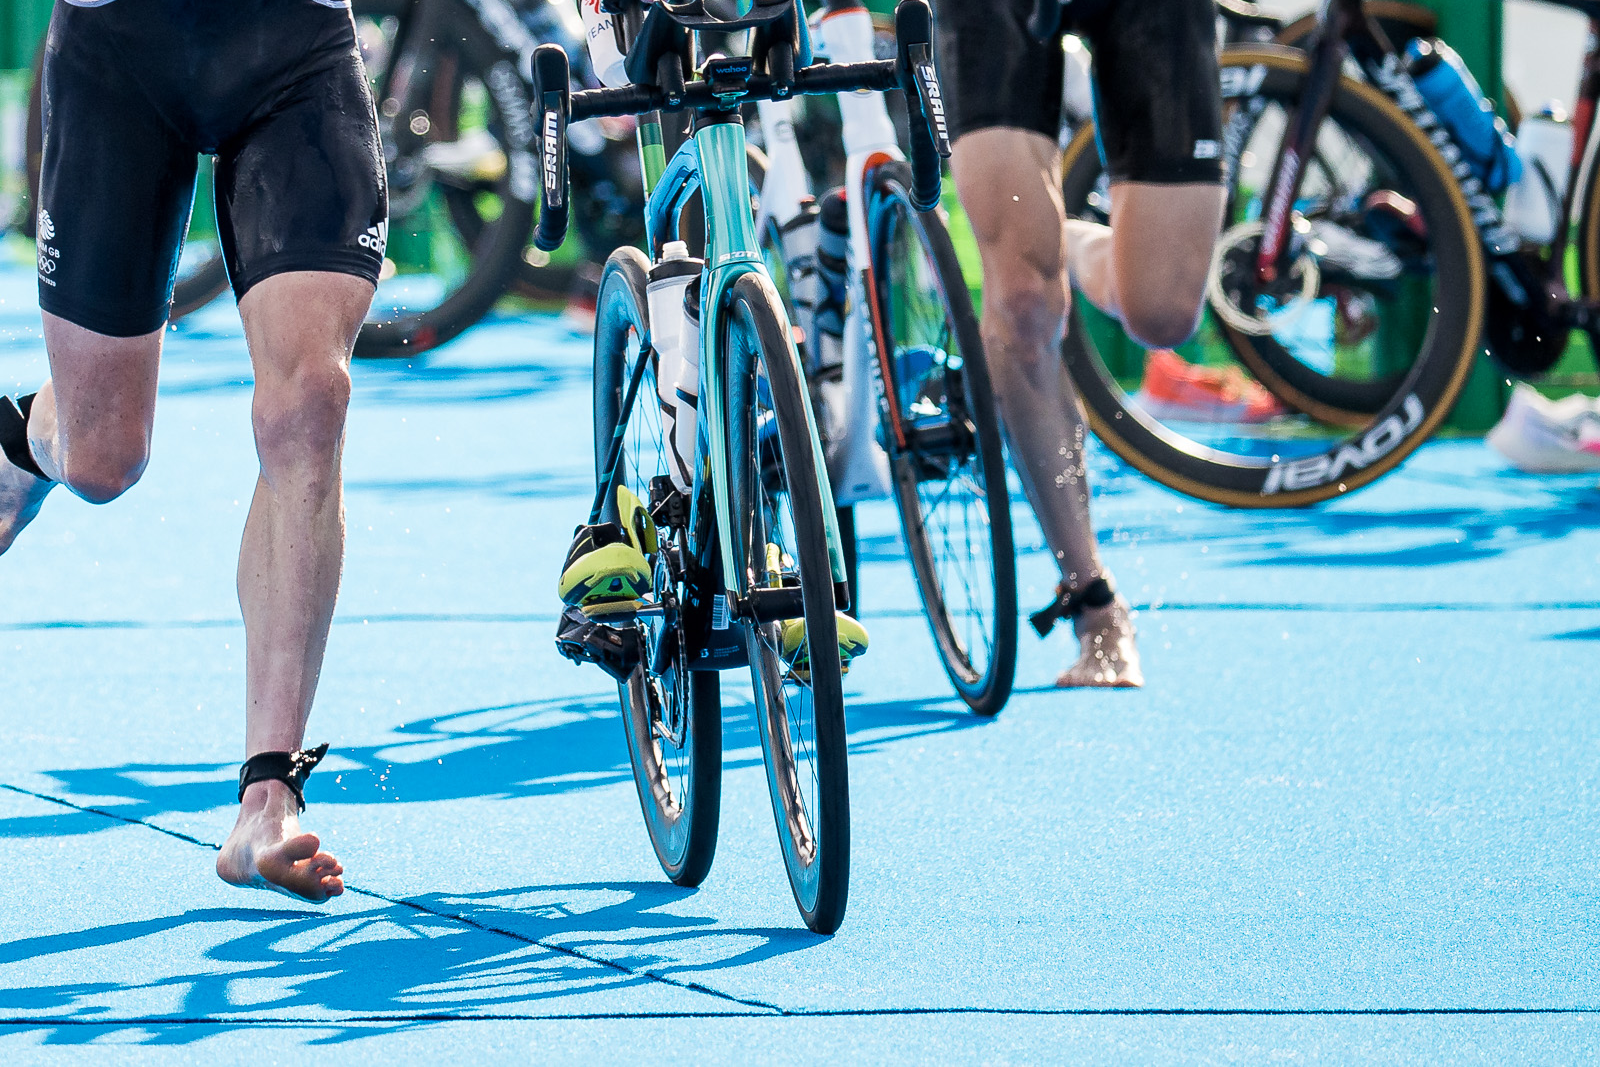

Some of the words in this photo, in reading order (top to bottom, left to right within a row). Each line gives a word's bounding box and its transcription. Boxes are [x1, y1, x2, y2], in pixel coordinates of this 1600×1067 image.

[715, 65, 748, 74] wahoo
[920, 65, 949, 140] SRAM
[544, 111, 558, 190] SRAM
[47, 246, 61, 259] GB
